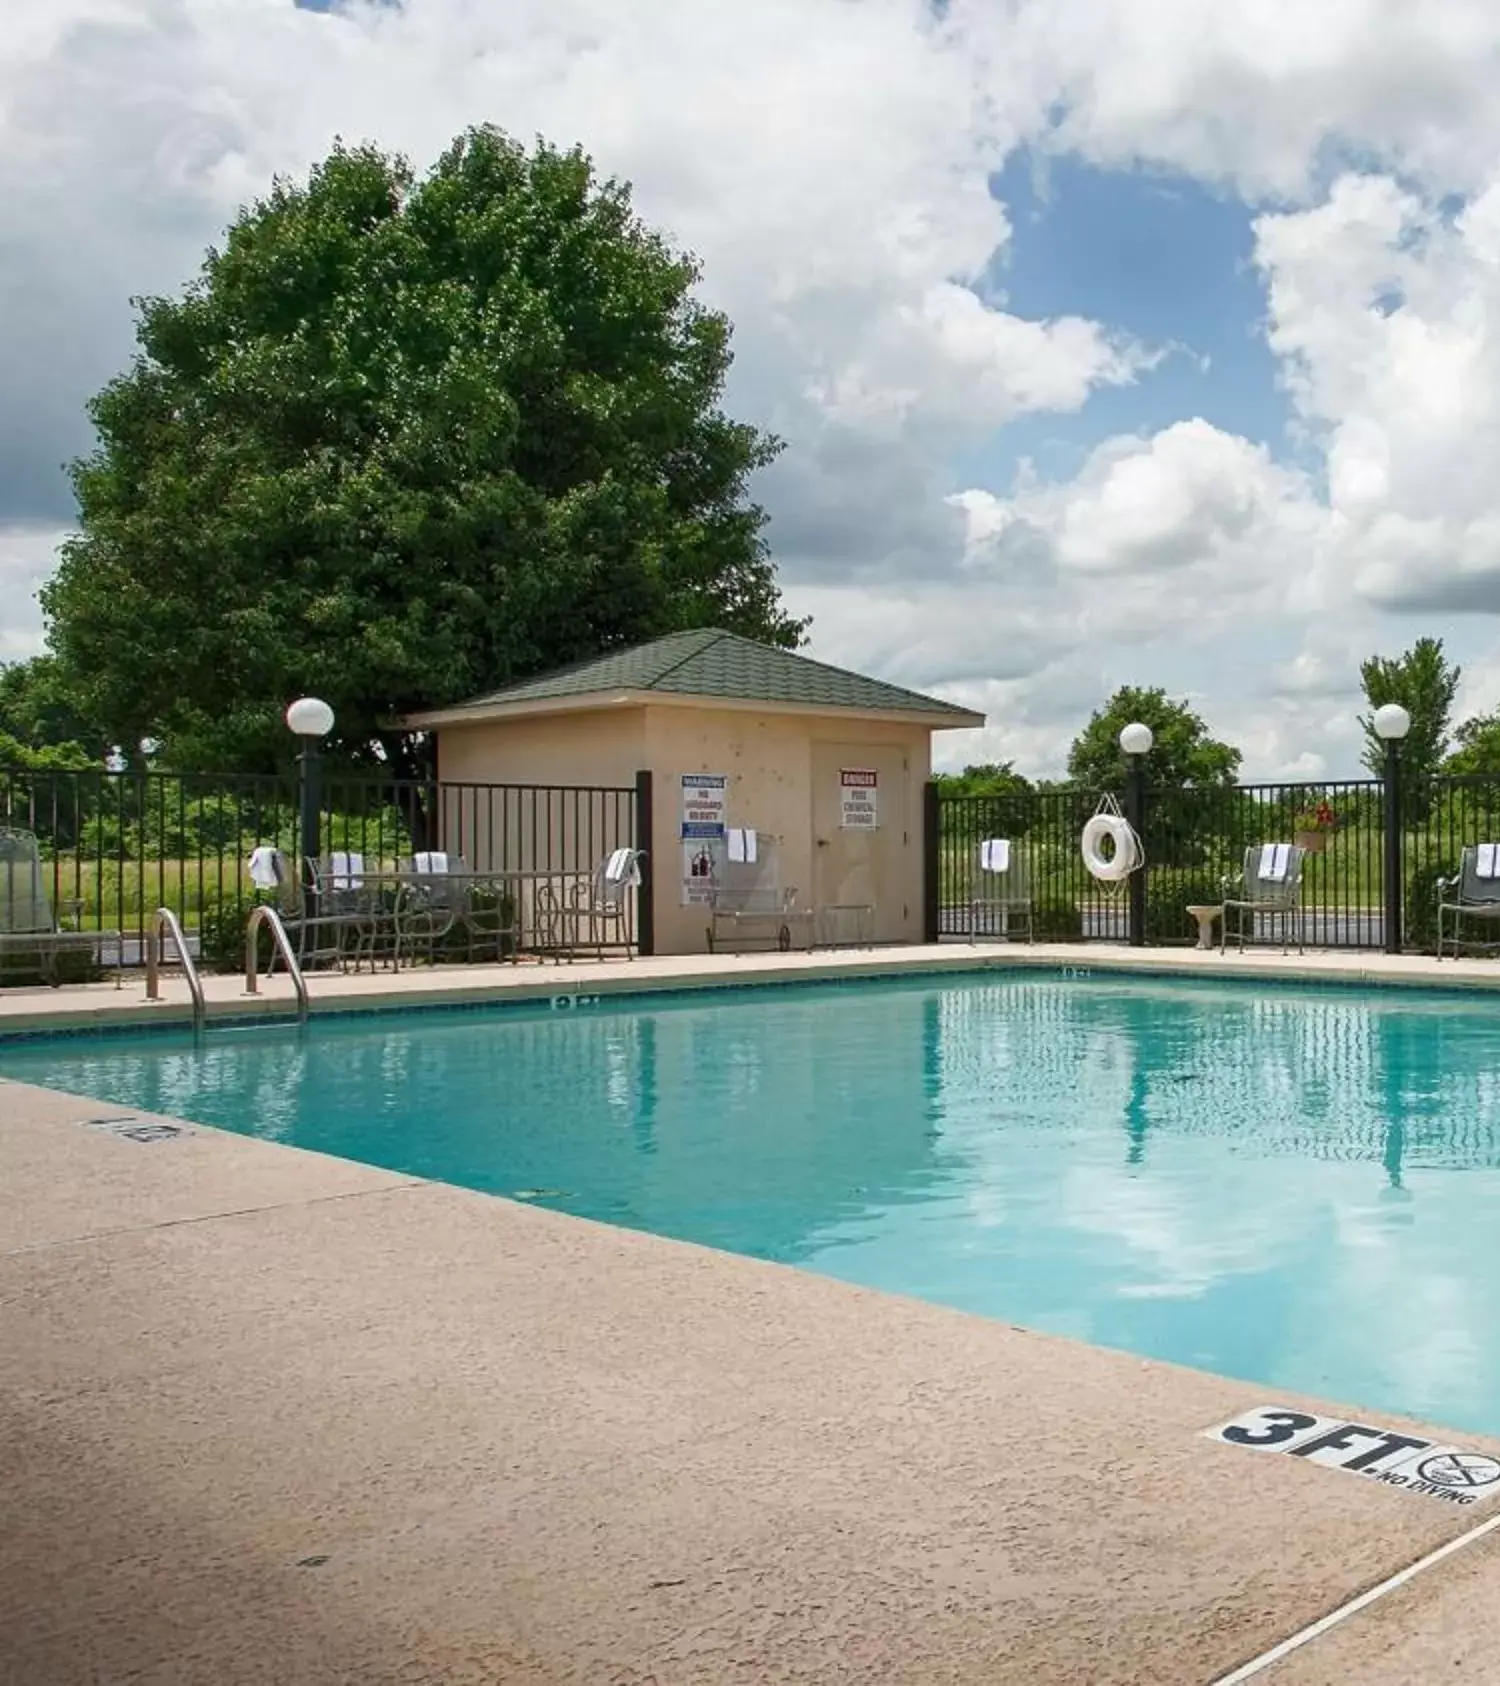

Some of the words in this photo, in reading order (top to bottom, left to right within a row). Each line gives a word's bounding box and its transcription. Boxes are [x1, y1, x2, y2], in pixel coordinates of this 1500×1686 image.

[1222, 1413, 1317, 1445] 3
[1376, 1472, 1410, 1485] NO
[1406, 1481, 1477, 1505] DIVING
